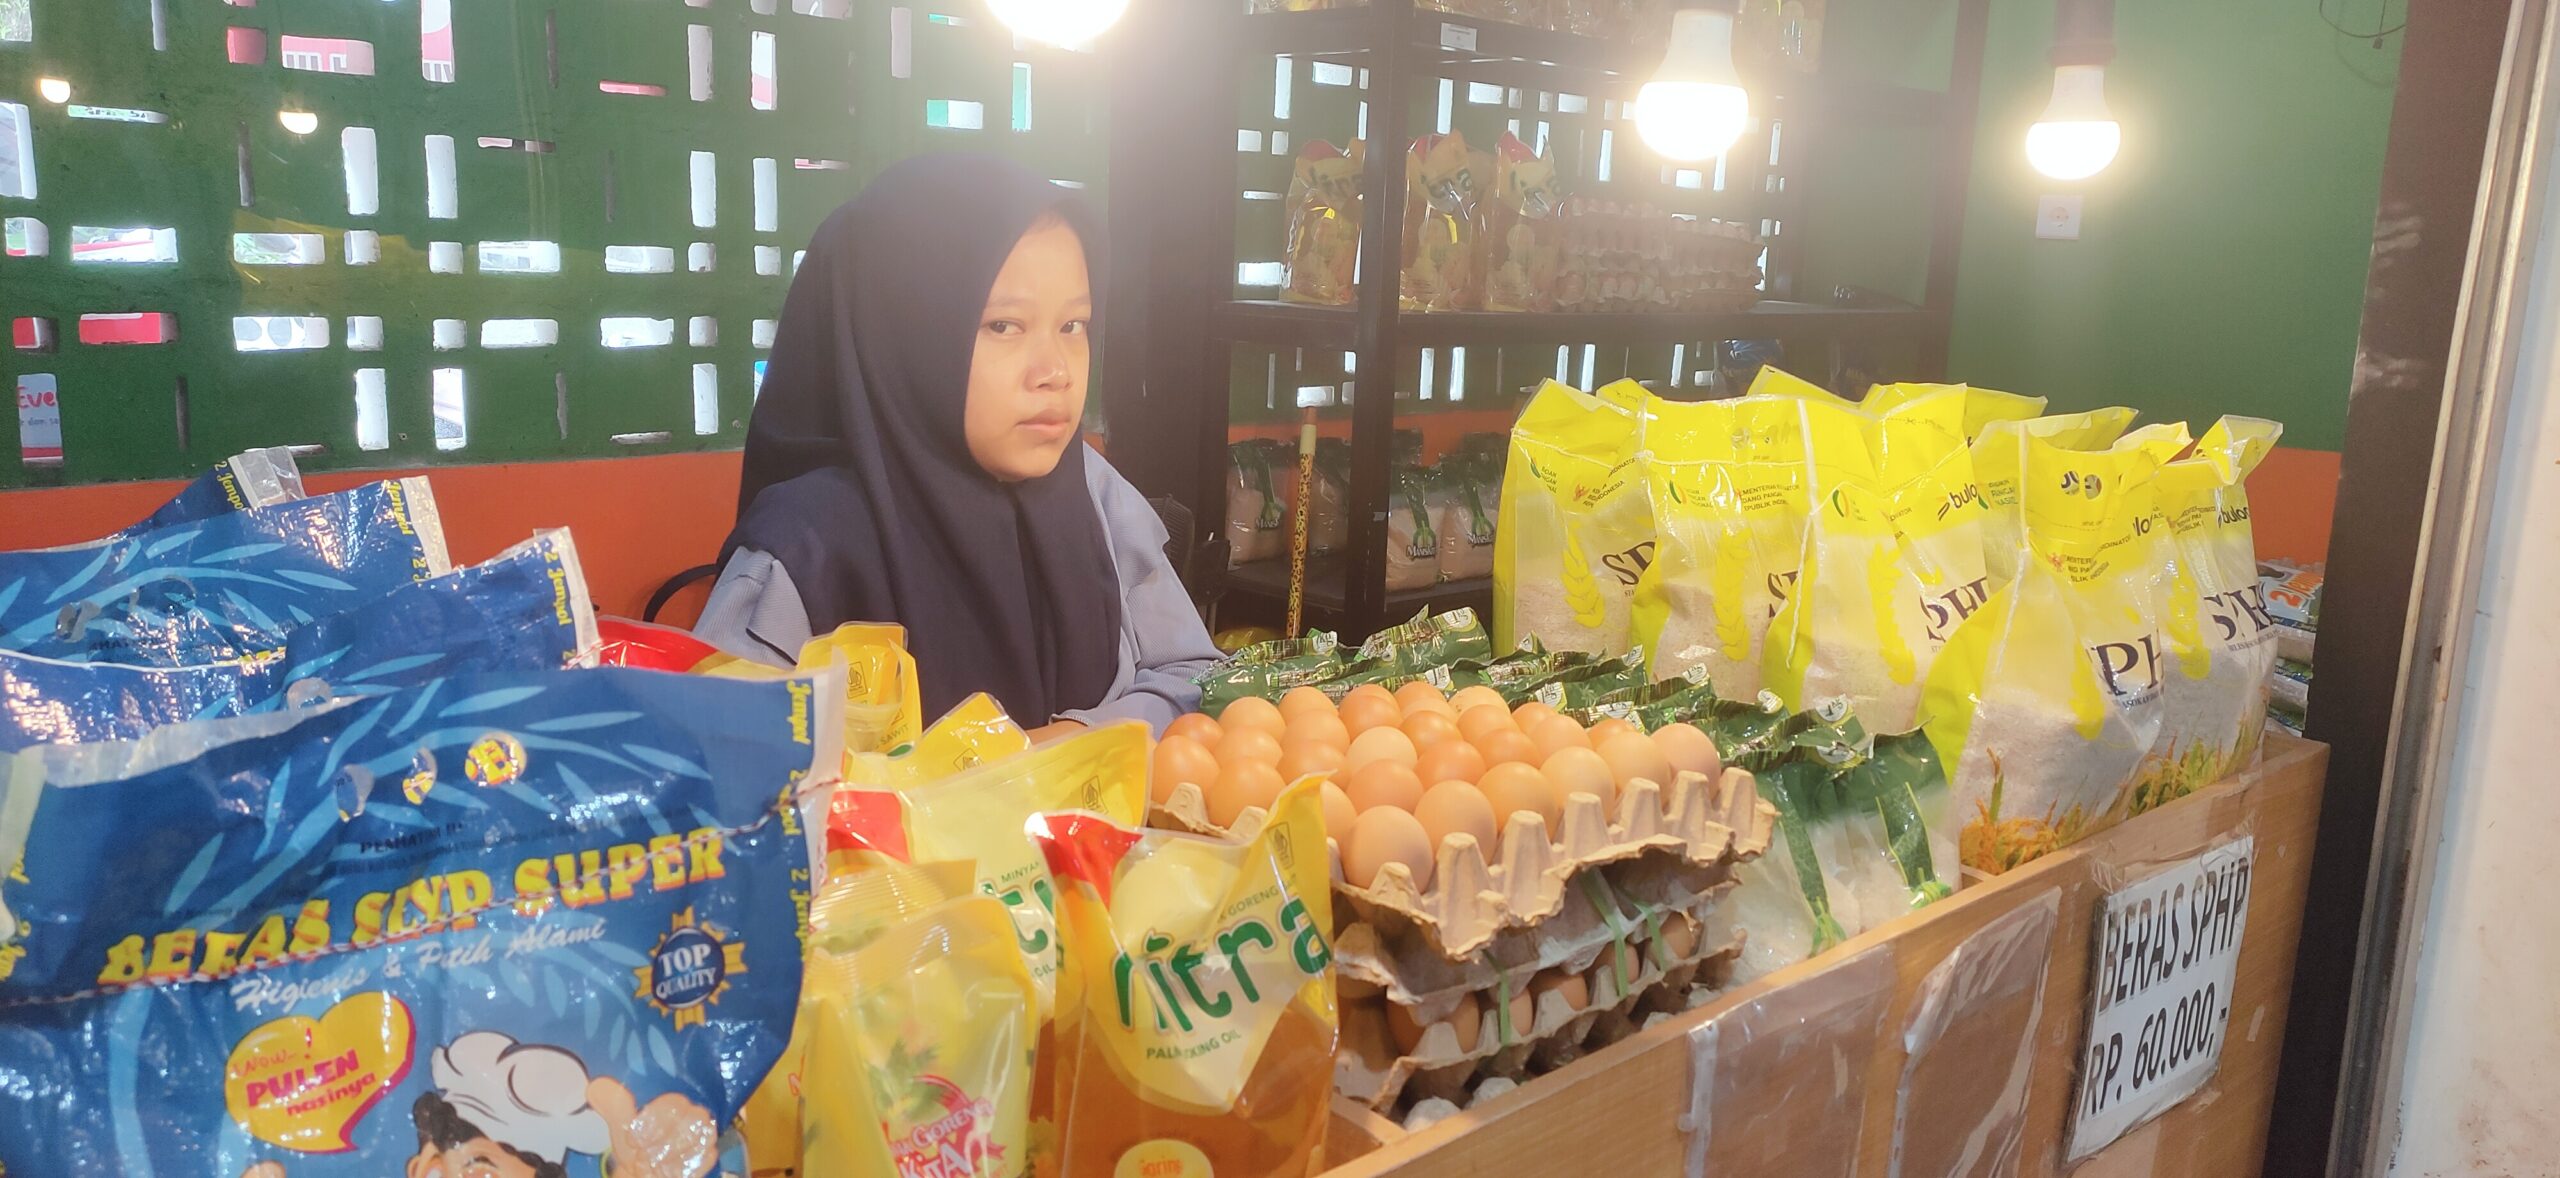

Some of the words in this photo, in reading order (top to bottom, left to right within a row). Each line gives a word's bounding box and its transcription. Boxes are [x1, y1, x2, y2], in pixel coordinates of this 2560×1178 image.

[217, 472, 243, 510] Jempo
[1949, 483, 1977, 509] bulo
[2221, 506, 2248, 524] bulo
[514, 826, 726, 917] SUPER
[2099, 882, 2186, 1014] BERAS
[2182, 856, 2249, 973] SPHP
[229, 967, 368, 1013] Higienis
[383, 953, 402, 978] &
[504, 916, 607, 960] Alami
[658, 943, 712, 978] TOP
[655, 967, 717, 1000] QUALITY
[246, 1048, 360, 1109] PULEN
[286, 1072, 377, 1117] nasinya
[2080, 1031, 2124, 1121] RP.
